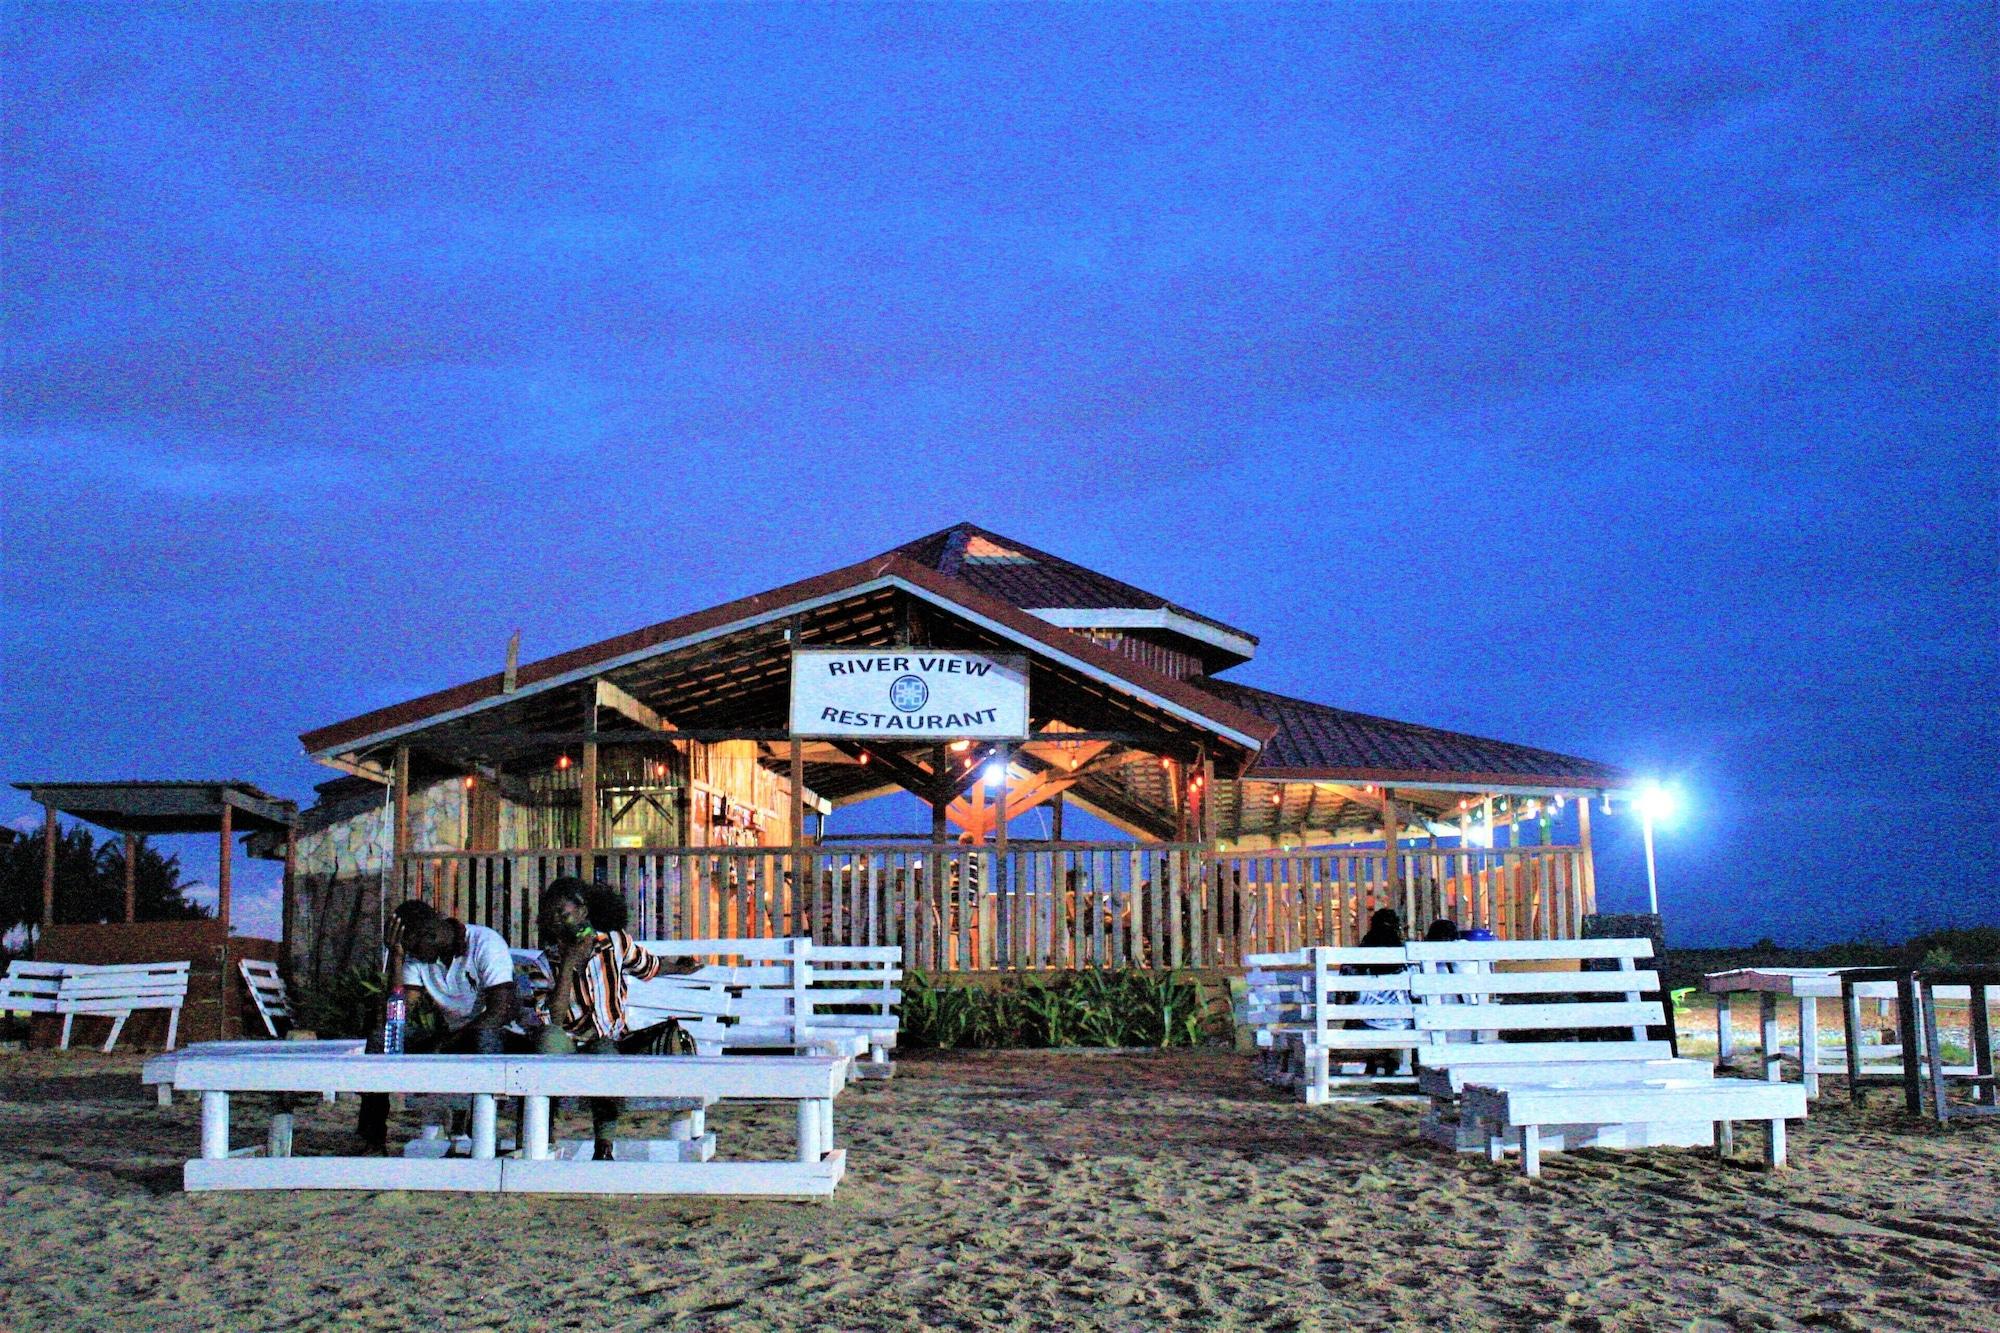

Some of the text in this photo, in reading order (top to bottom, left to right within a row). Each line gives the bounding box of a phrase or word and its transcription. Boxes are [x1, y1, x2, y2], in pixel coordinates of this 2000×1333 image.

[828, 657, 992, 677] RIVER VIEW
[820, 706, 998, 730] RESTAURANT
